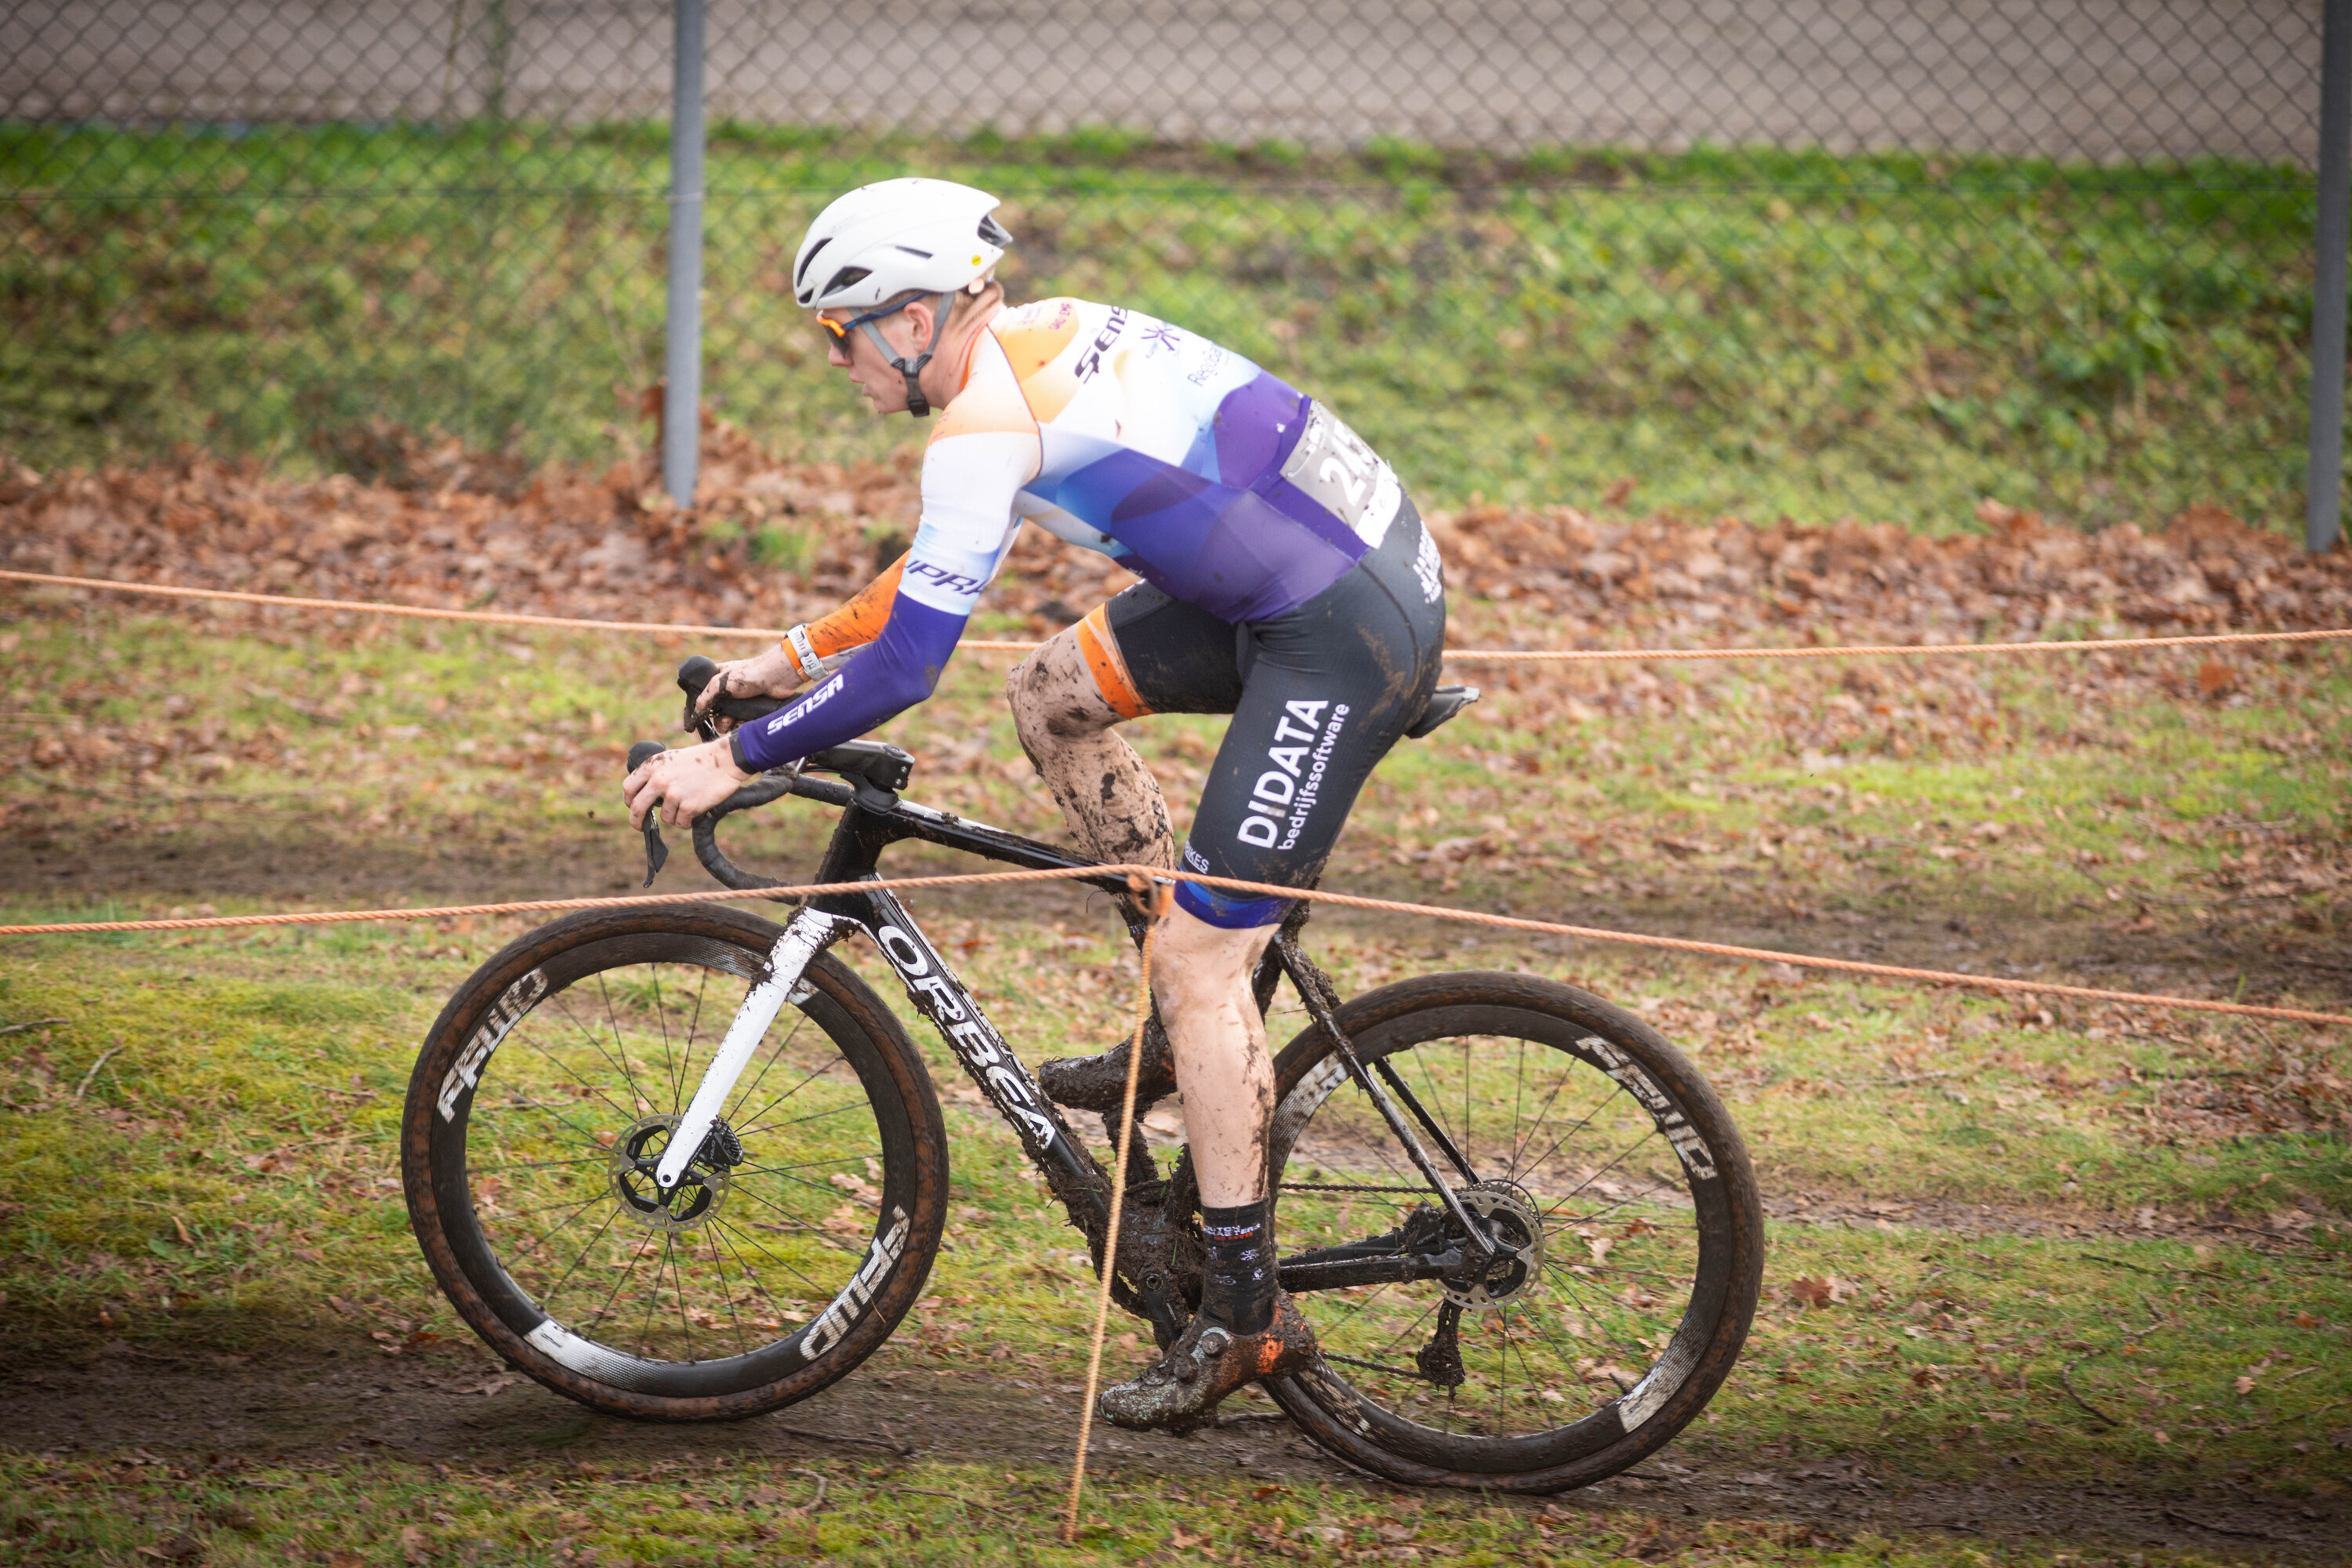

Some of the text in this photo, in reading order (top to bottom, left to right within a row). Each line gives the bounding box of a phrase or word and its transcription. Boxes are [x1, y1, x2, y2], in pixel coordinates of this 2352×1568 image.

[767, 673, 844, 735] SENSA
[1237, 700, 1329, 849] DIDATA
[1277, 704, 1350, 851] bedrijfssoftware
[878, 925, 1056, 1150] ORBEA
